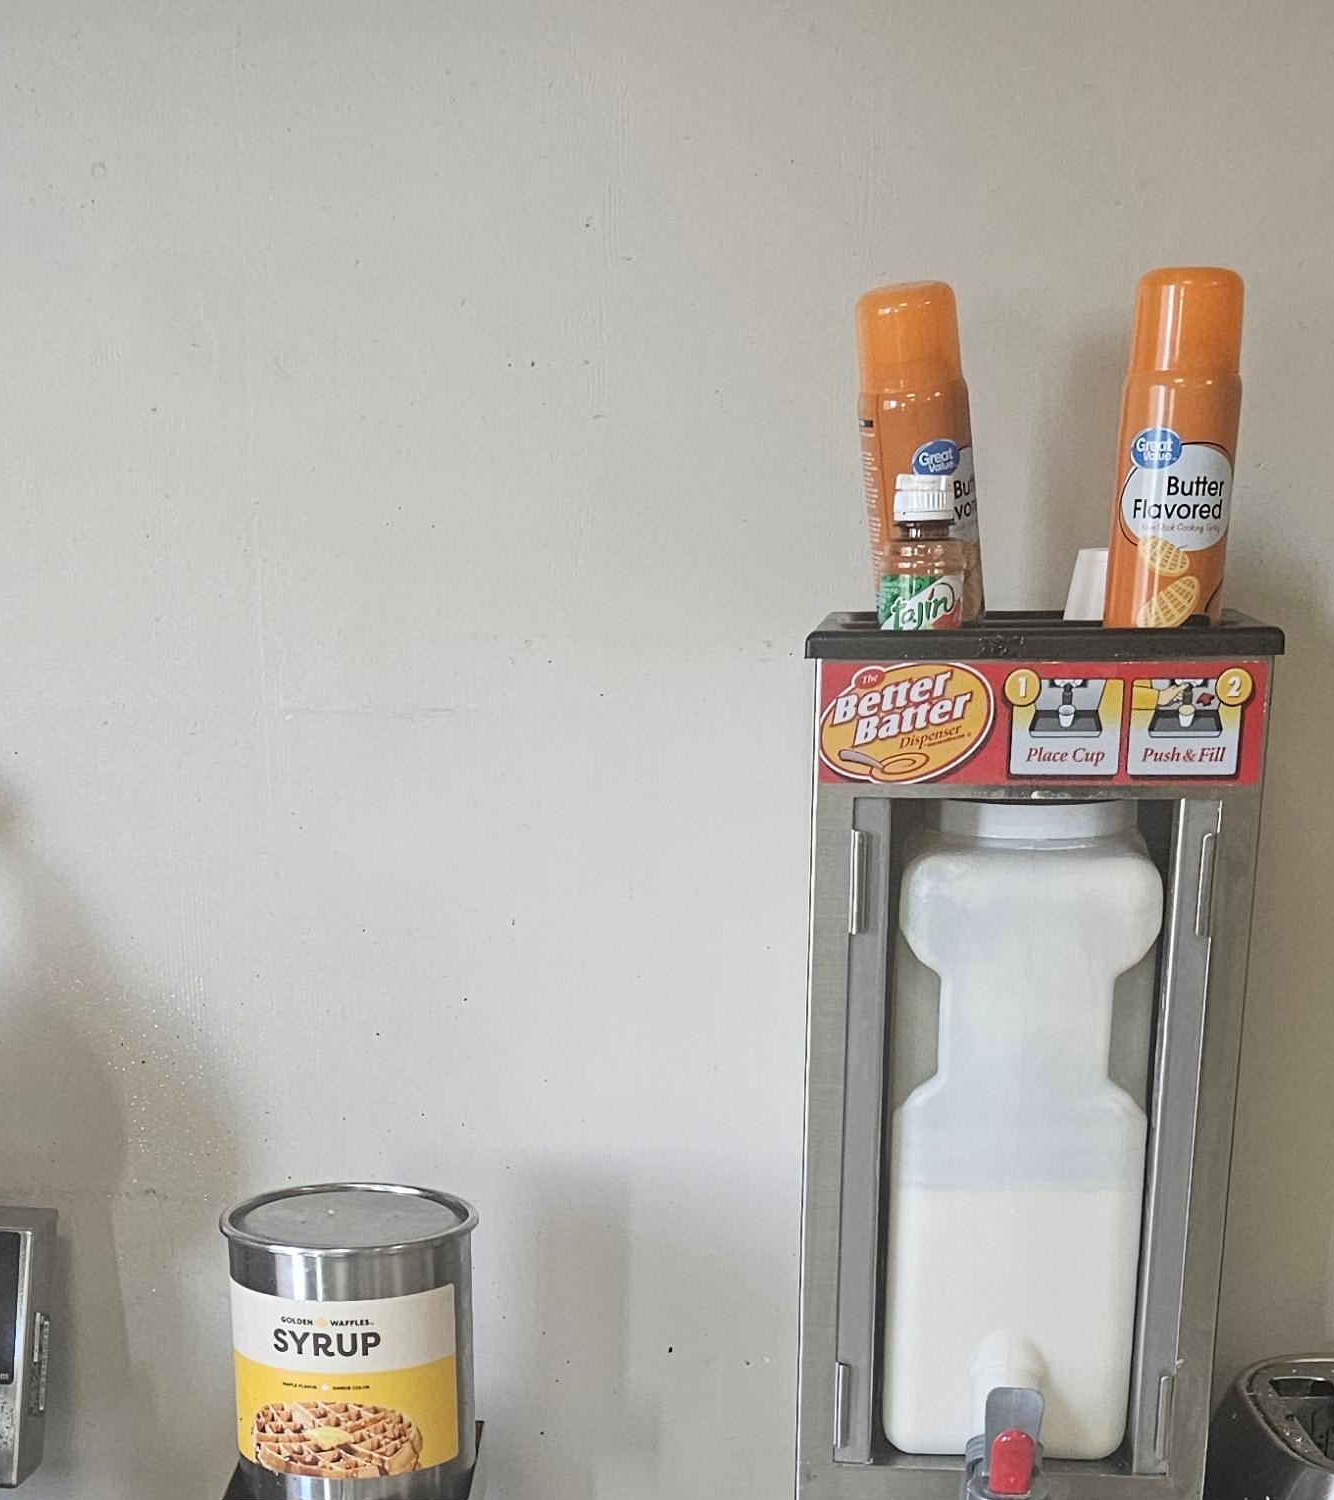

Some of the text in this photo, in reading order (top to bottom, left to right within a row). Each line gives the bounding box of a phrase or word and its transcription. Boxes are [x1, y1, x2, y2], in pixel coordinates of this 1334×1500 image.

[1136, 437, 1173, 452] Great
[918, 450, 954, 467] Great
[1143, 451, 1172, 462] Value
[1167, 476, 1224, 497] Butter
[1133, 499, 1223, 520] Flavored
[861, 673, 879, 685] The
[1017, 676, 1027, 698] 1
[1227, 676, 1241, 698] 2
[830, 669, 955, 727] Better
[852, 691, 973, 748] Batter
[899, 725, 962, 750] Dispenser
[1026, 747, 1105, 766] Place Cup
[1142, 746, 1226, 763] Push & Fill
[281, 1316, 313, 1326] GOLDEN
[273, 1328, 381, 1357] SYRUP
